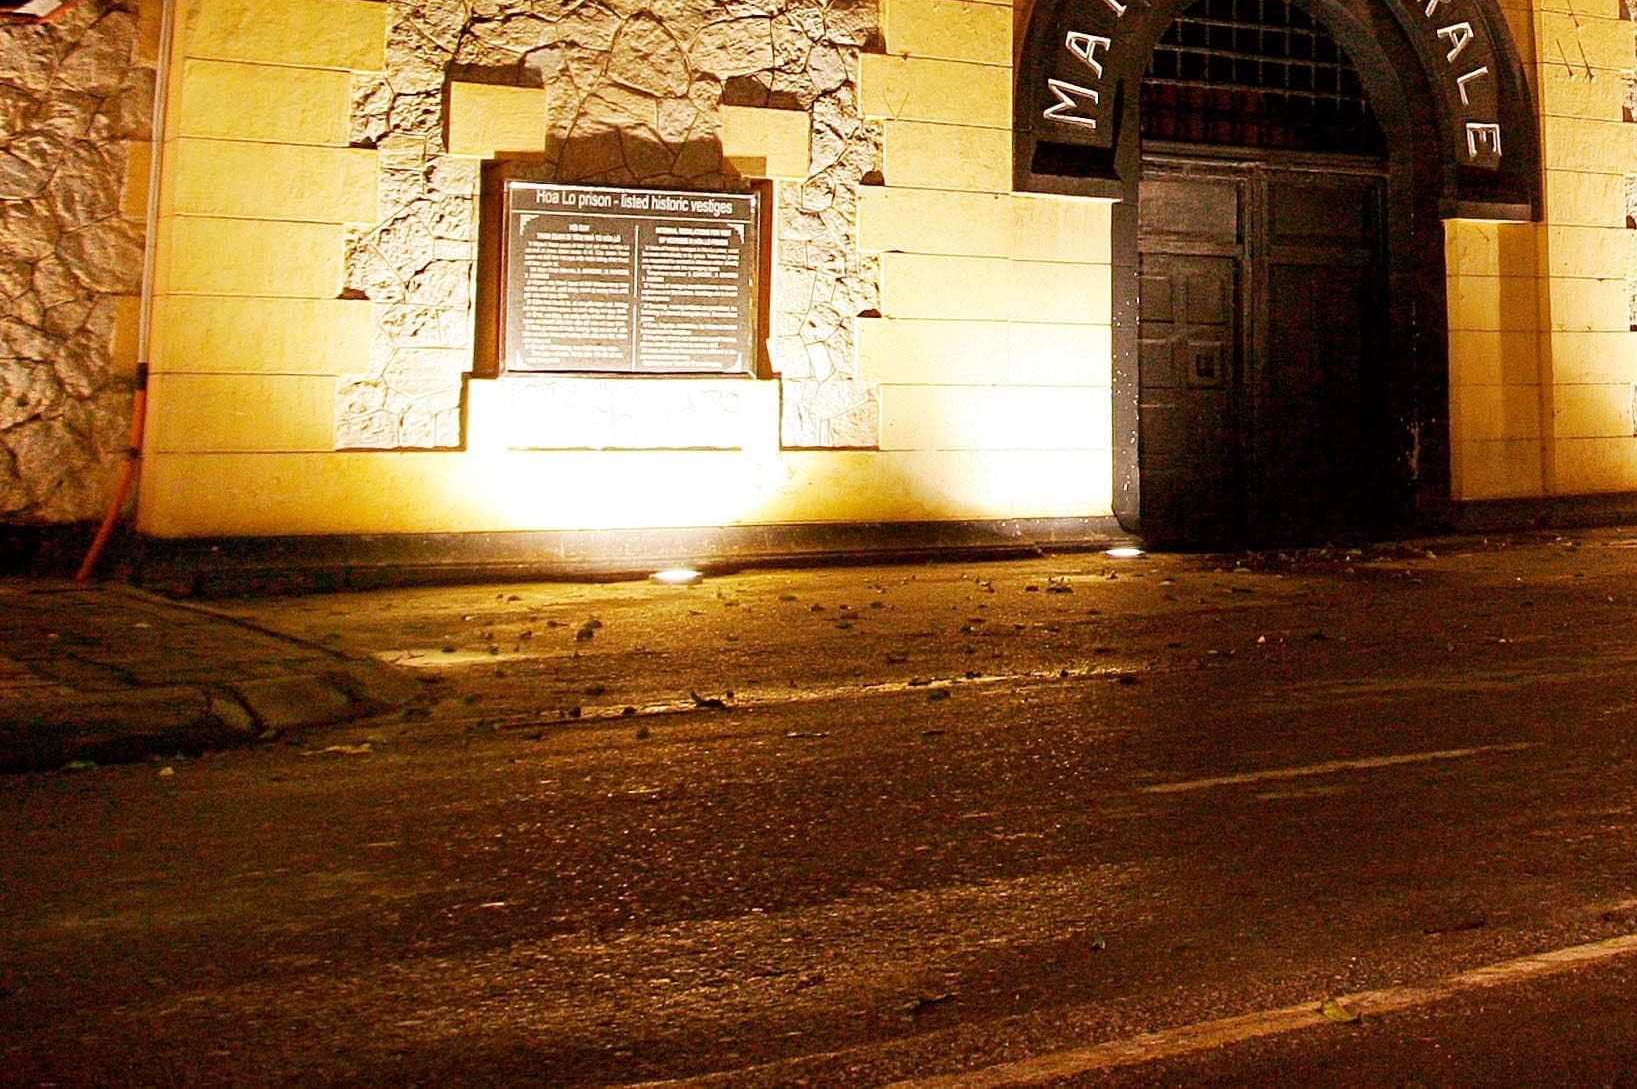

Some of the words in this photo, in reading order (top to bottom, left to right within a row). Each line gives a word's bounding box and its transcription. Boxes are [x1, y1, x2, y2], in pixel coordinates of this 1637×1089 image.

[536, 189, 559, 204] Hoa
[562, 190, 576, 205] Lo
[579, 193, 611, 209] prison
[621, 193, 649, 209] listed
[651, 196, 689, 212] historic
[691, 198, 732, 216] vestiges
